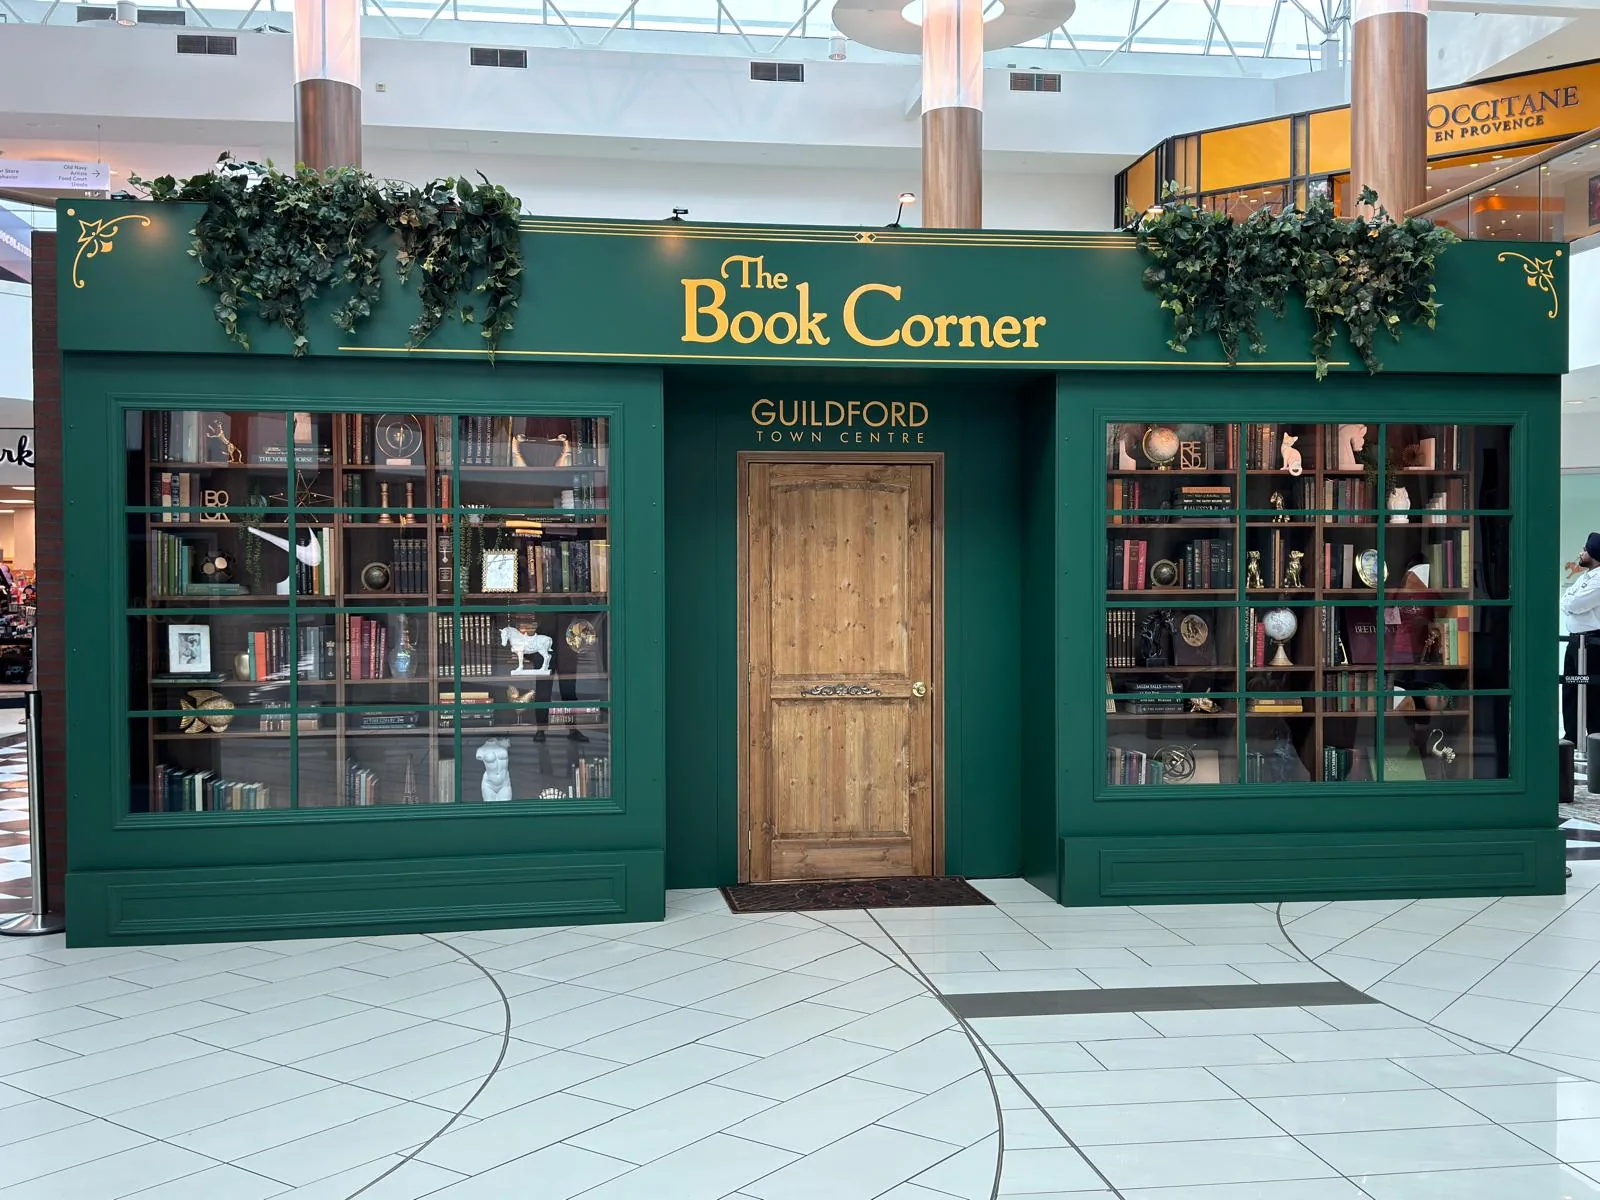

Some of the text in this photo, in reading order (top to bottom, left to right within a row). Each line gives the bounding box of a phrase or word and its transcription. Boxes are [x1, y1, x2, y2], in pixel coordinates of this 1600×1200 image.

[1434, 115, 1545, 142] EN PROVENCE
[721, 255, 788, 290] The
[681, 279, 1047, 349] Book Corner
[751, 399, 929, 427] GUILDFORD
[756, 430, 925, 444] TOWN CENTRE
